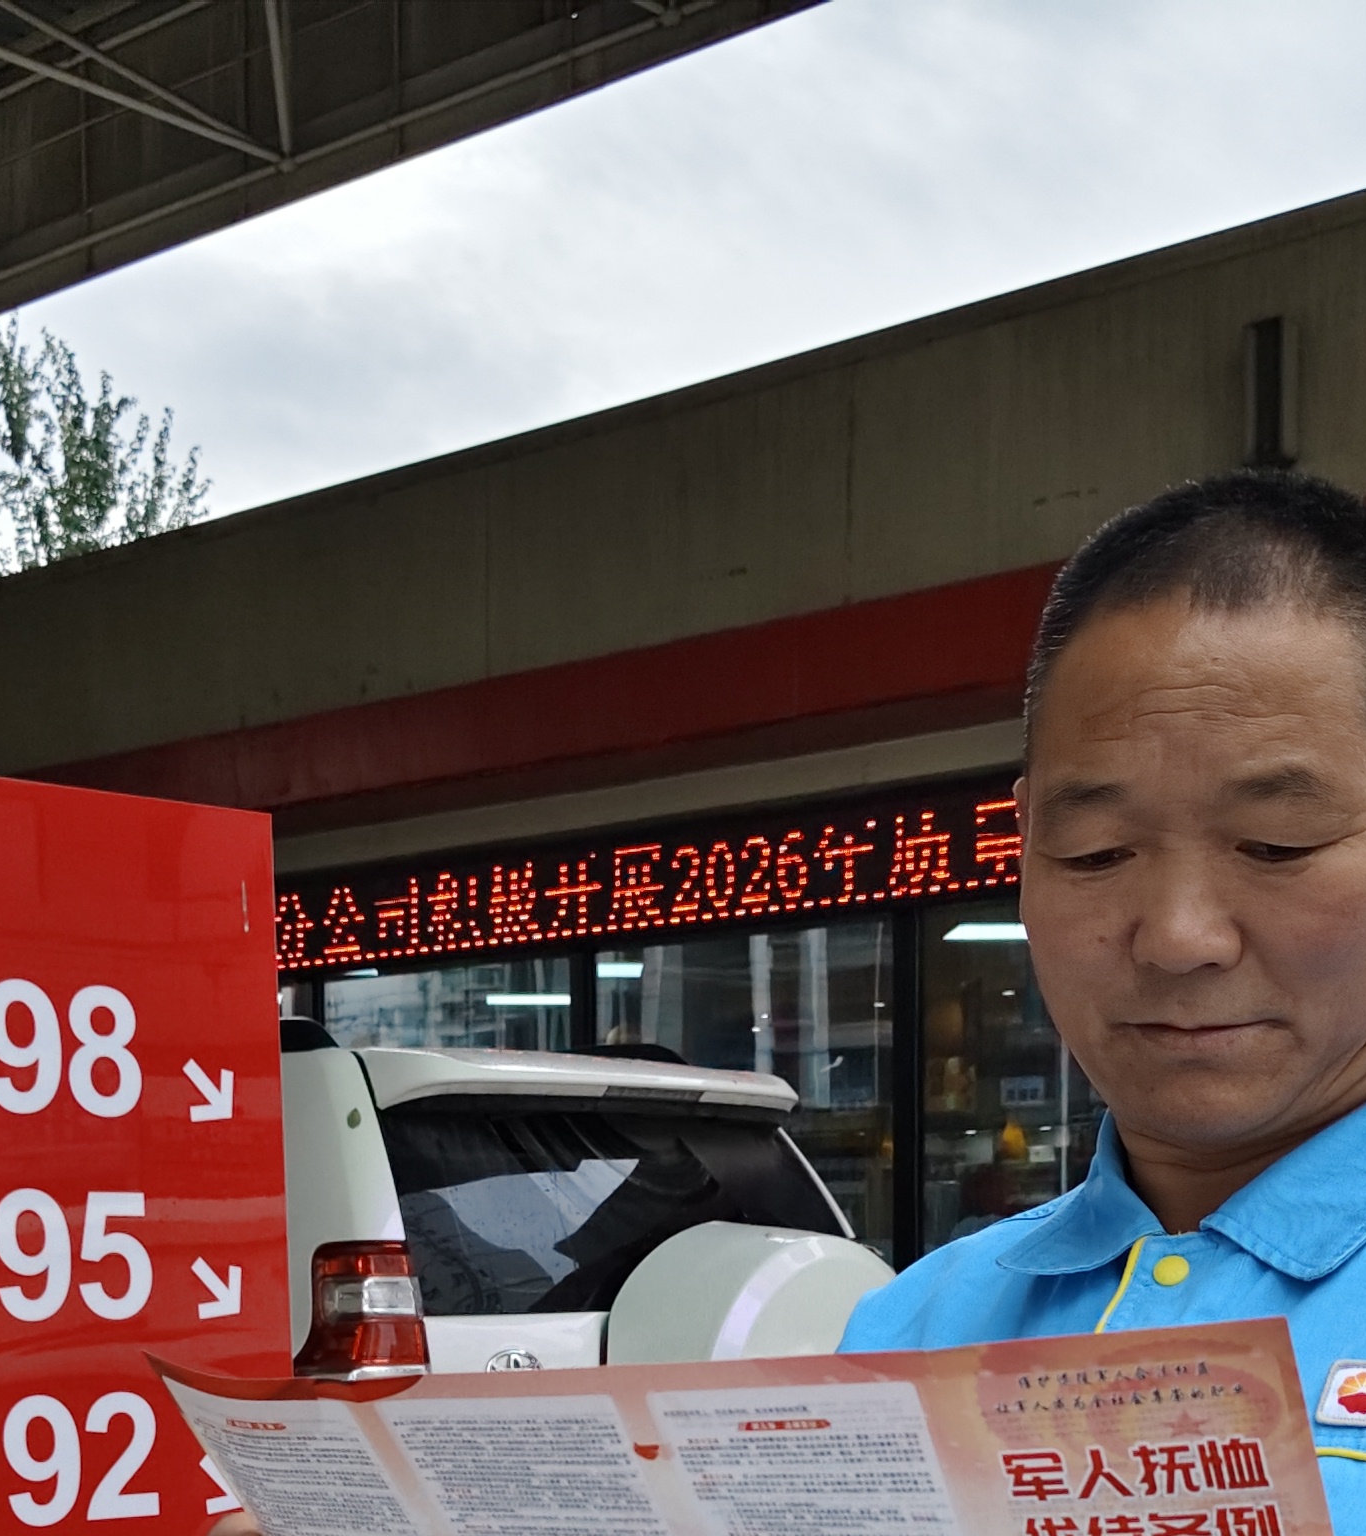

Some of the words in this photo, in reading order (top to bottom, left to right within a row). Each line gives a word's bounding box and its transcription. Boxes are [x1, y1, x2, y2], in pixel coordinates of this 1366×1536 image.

[1, 1390, 161, 1528] 92
[1001, 1436, 1272, 1502] 军人抚恤
